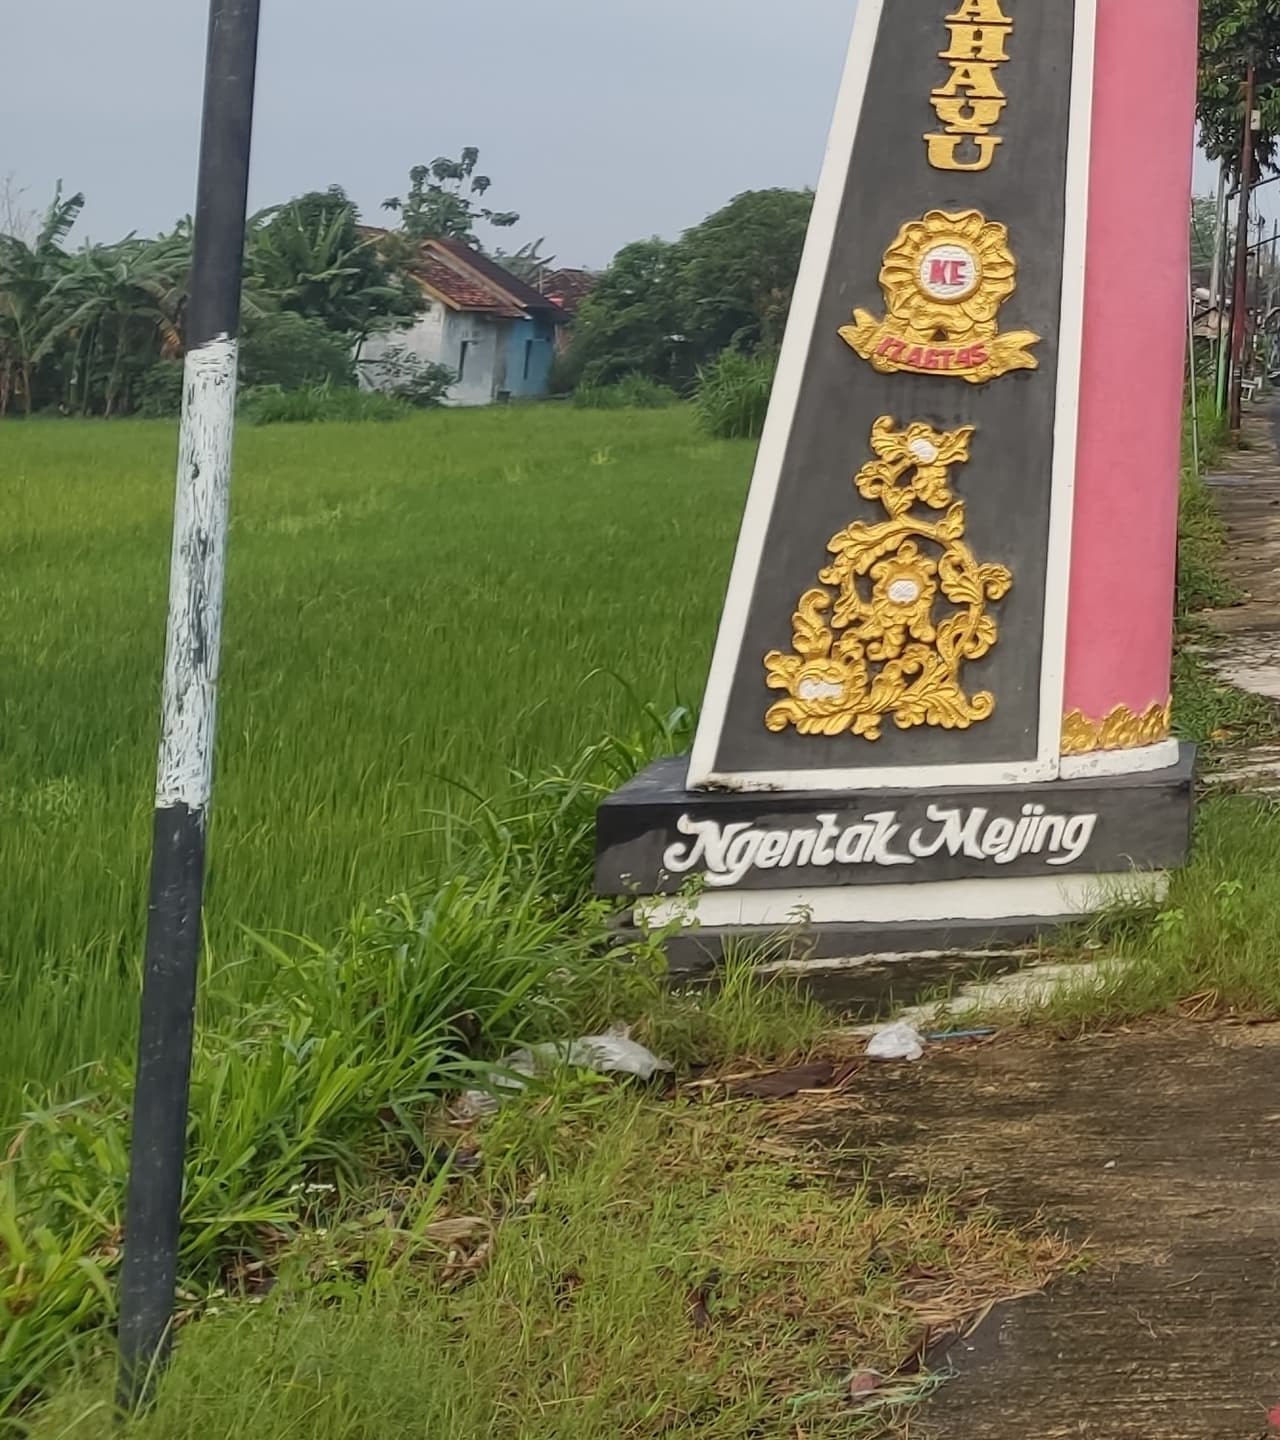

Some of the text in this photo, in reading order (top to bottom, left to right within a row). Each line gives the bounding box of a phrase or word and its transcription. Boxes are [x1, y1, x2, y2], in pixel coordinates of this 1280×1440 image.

[928, 259, 967, 286] KE
[663, 803, 1098, 887] Ngentak Mejing
